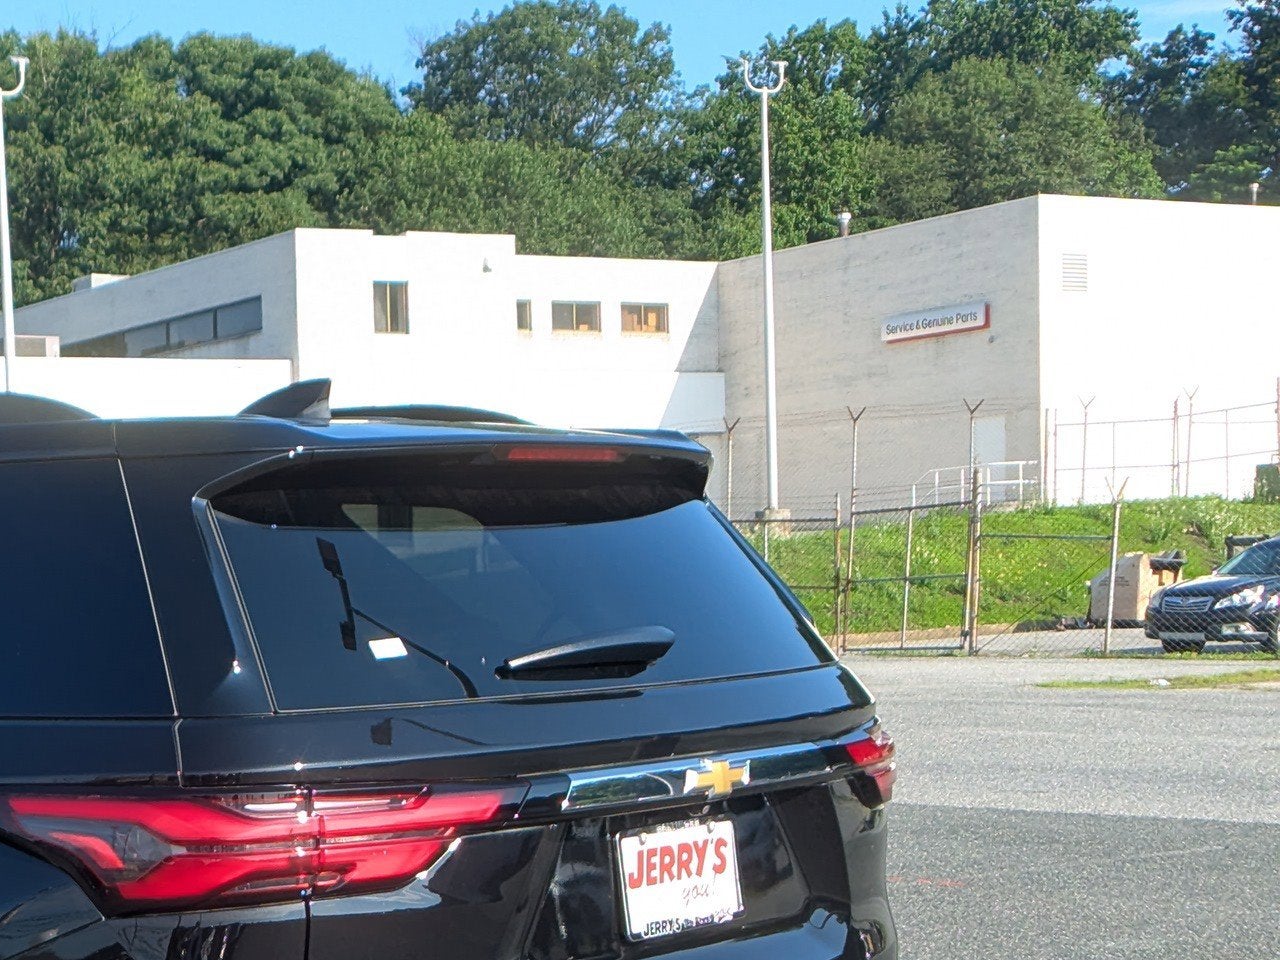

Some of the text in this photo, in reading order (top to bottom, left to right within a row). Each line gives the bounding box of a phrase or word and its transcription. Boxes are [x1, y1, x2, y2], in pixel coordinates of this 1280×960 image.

[886, 310, 978, 336] Service & Genuine Parts
[628, 837, 729, 889] JERRY'S
